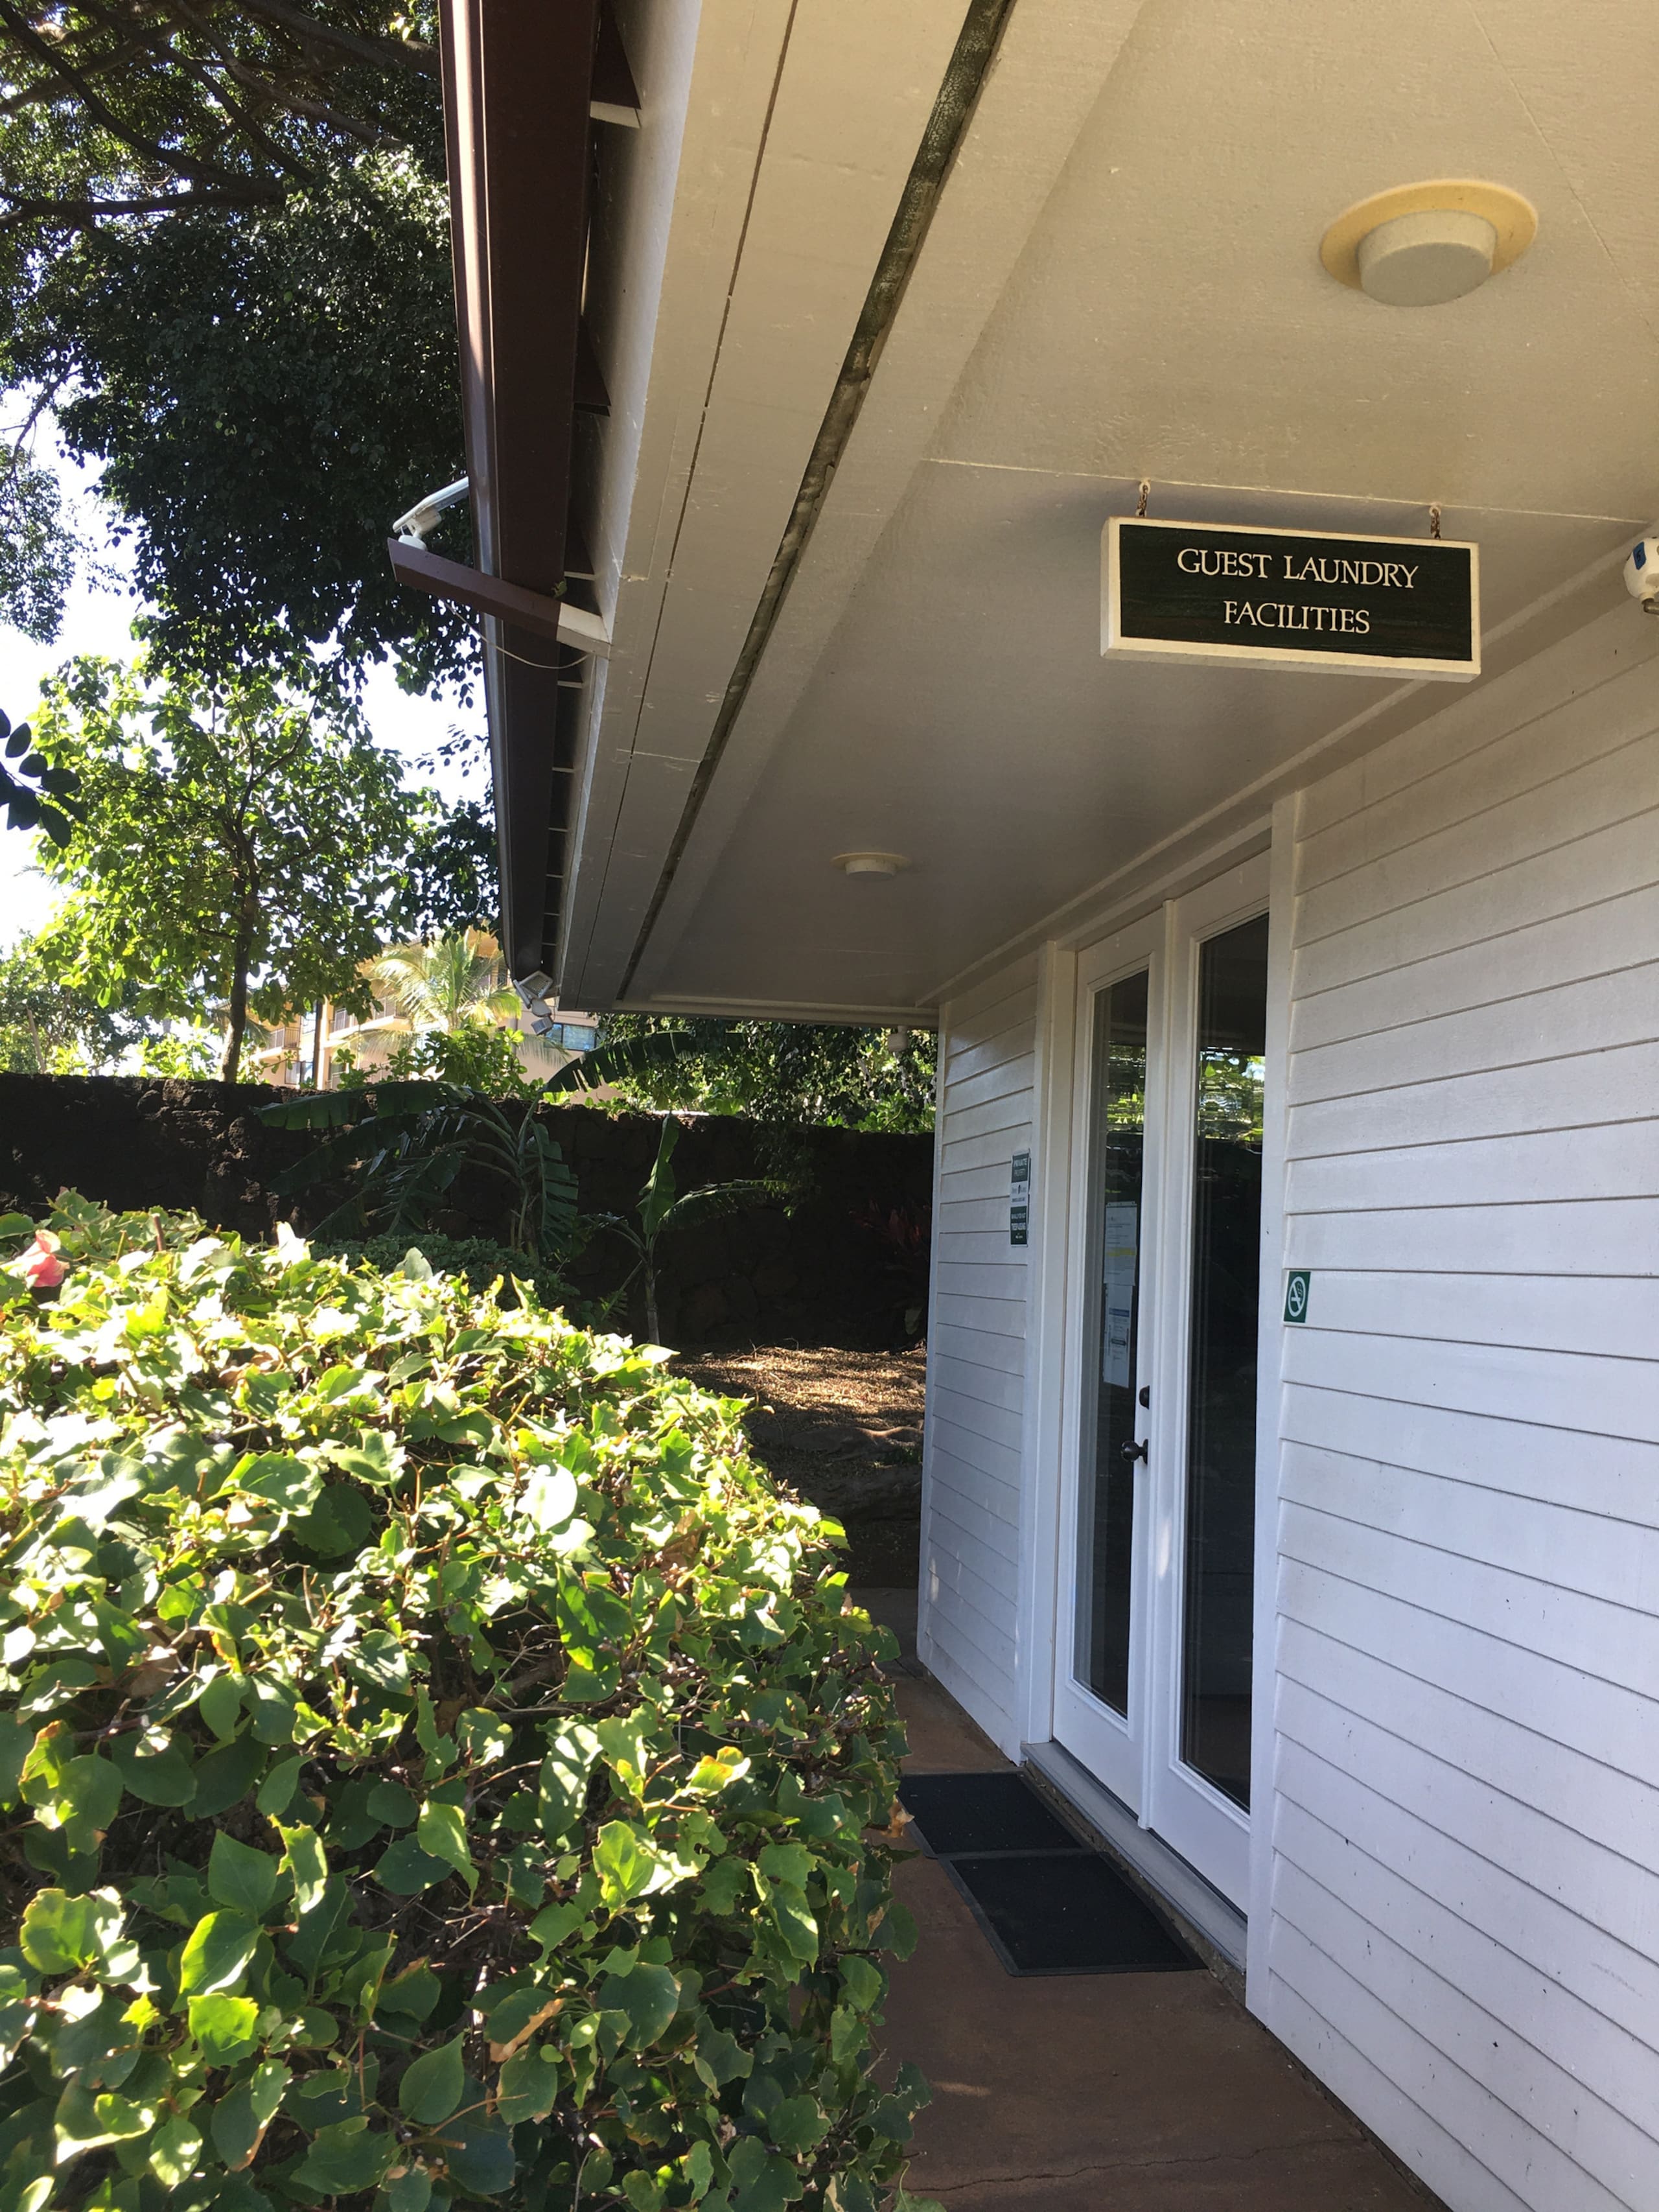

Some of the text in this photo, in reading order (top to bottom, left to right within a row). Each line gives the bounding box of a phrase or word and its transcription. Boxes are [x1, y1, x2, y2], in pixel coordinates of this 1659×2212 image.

[1177, 548, 1419, 588] GUEST LAUNDRY
[1224, 601, 1370, 634] FACILITIES
